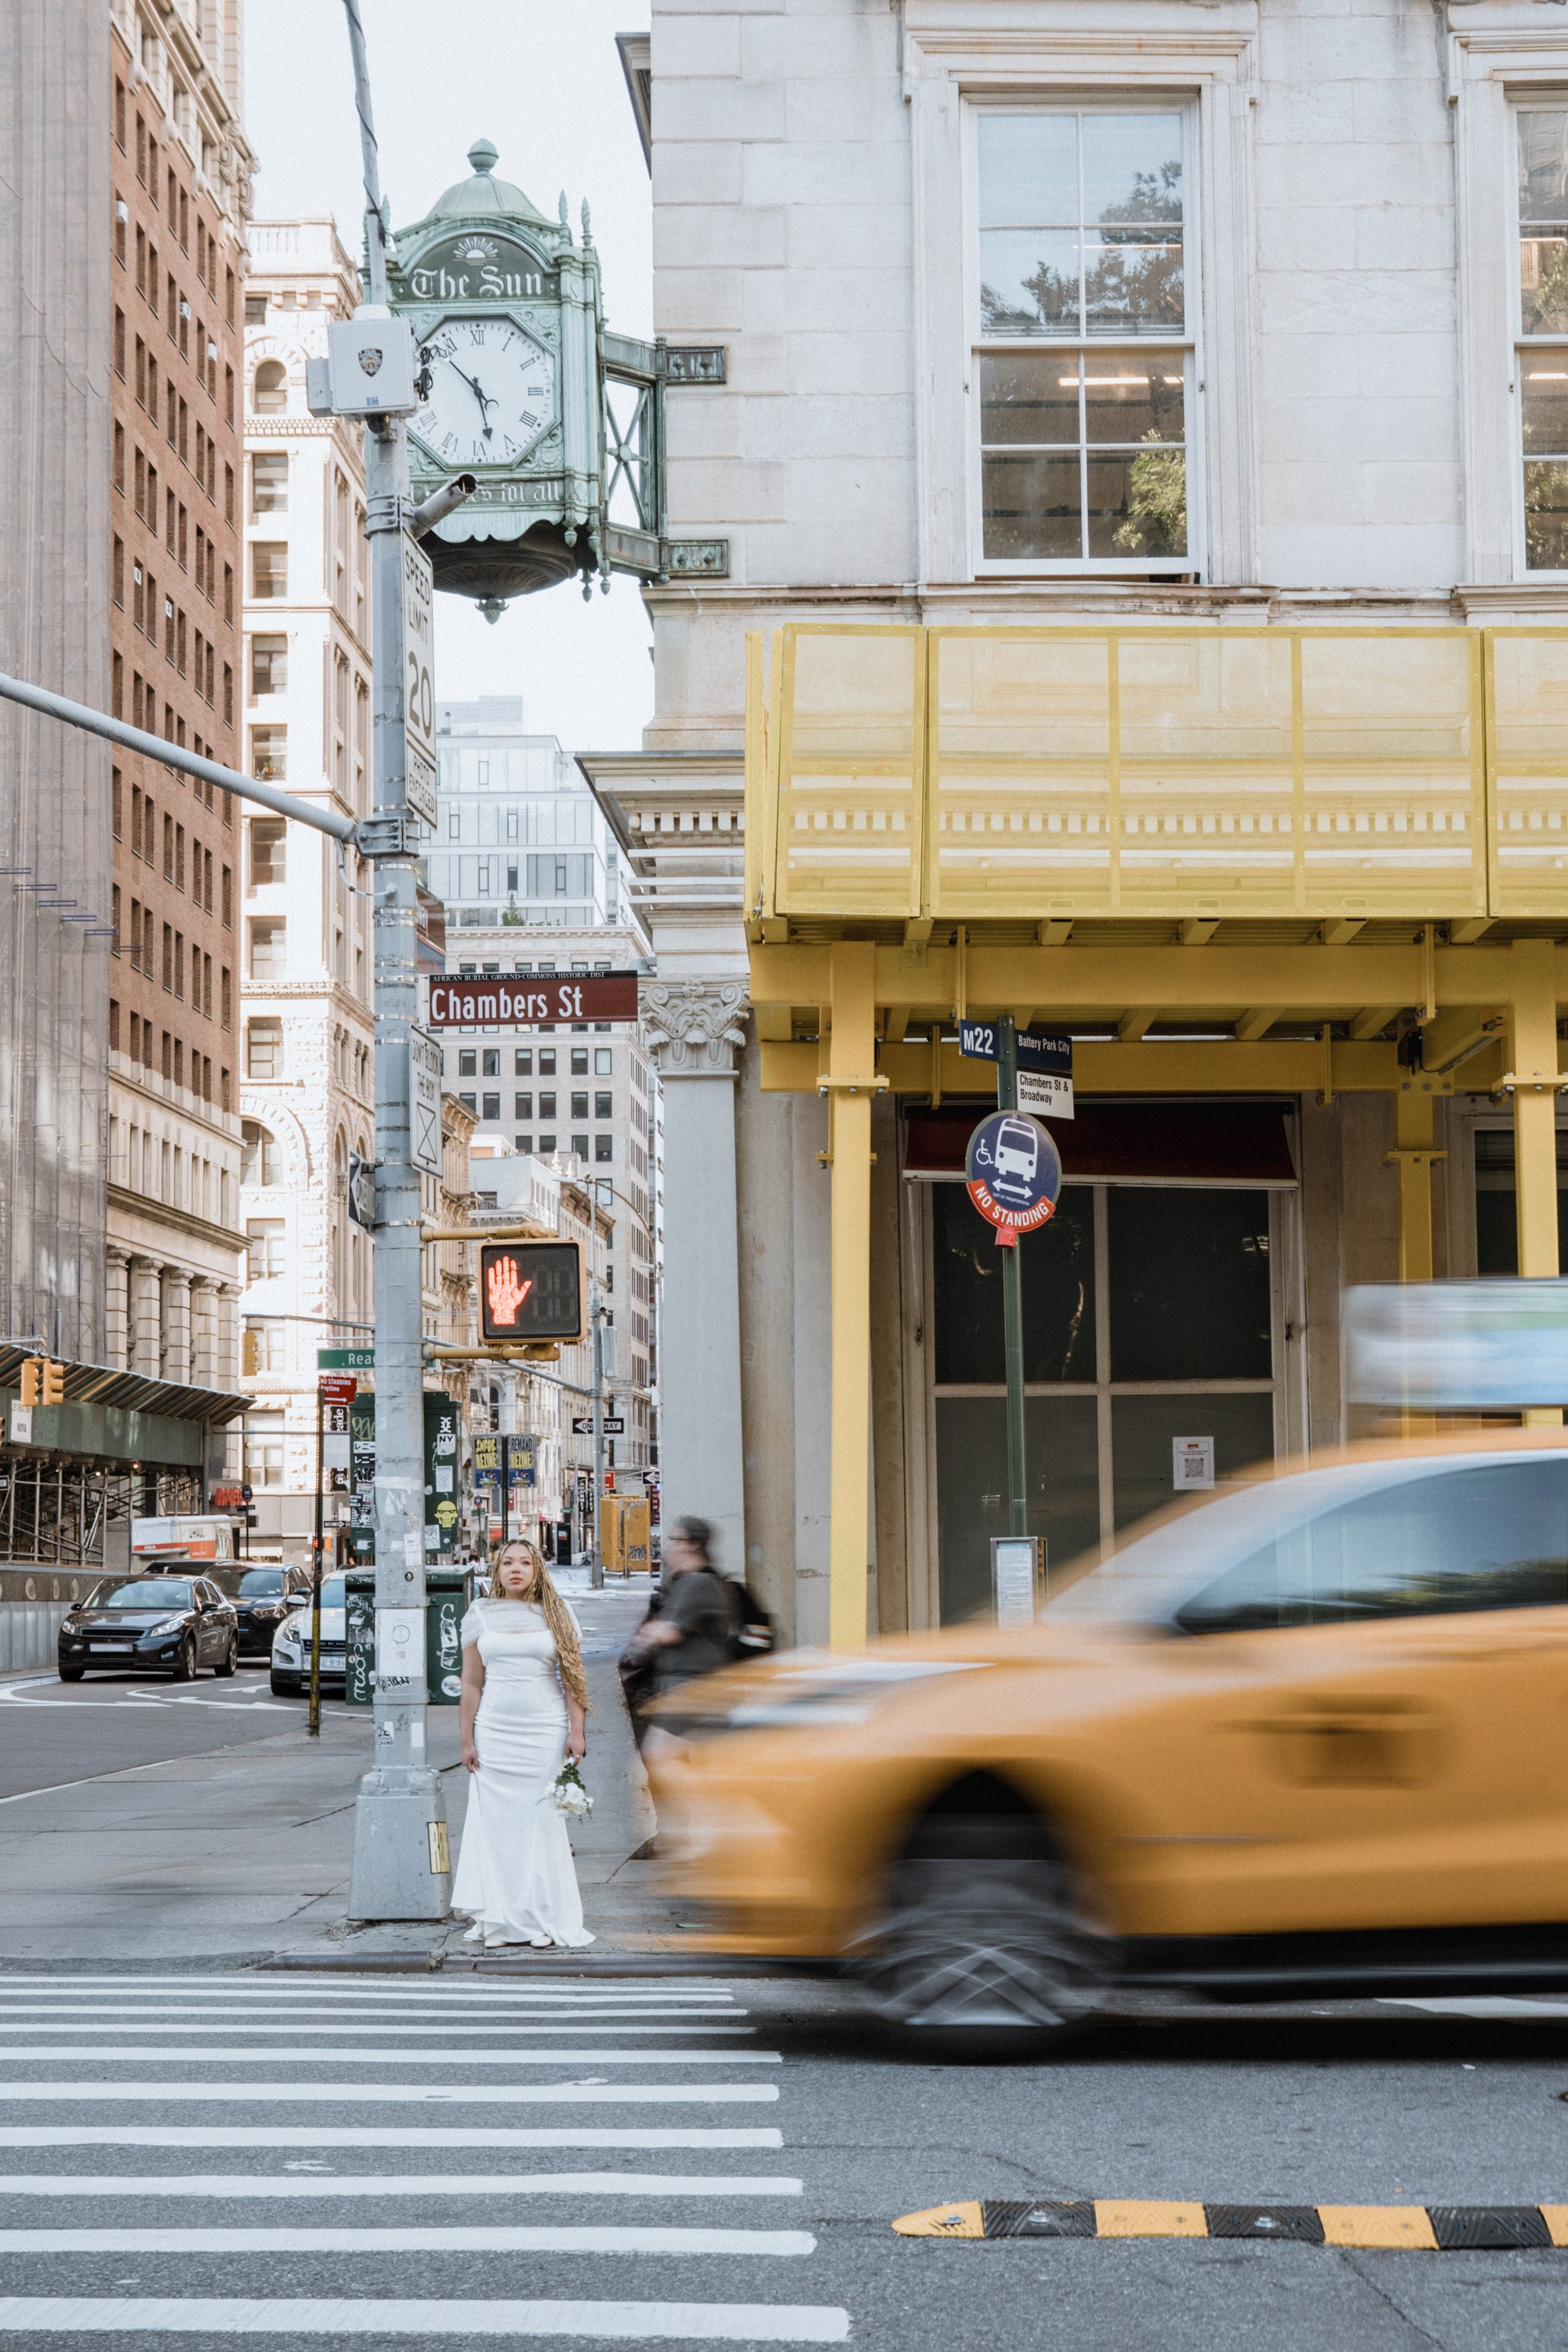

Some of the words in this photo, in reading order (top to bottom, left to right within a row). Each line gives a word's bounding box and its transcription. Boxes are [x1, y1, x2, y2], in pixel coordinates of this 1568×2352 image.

[412, 266, 470, 299] The
[479, 265, 543, 297] Sun
[470, 330, 485, 345] XII
[533, 481, 561, 502] all
[405, 550, 430, 606] SPEED
[408, 595, 428, 646] LIMIT
[408, 651, 431, 739] 20
[413, 753, 430, 786] PHOTO
[409, 772, 434, 813] ENFORCED
[431, 987, 548, 1021] Chambers
[558, 985, 583, 1018] St
[964, 1027, 993, 1054] M22
[1018, 1035, 1041, 1051] Battery
[1043, 1039, 1057, 1051] Park
[1058, 1040, 1070, 1055] City
[1020, 1073, 1052, 1090] Chambers
[1054, 1079, 1062, 1091] St
[1063, 1080, 1069, 1092] &
[1020, 1088, 1052, 1105] Broadway
[975, 1186, 992, 1207] NO
[992, 1202, 1049, 1227] STANDING
[511, 1438, 532, 1452] REMAND
